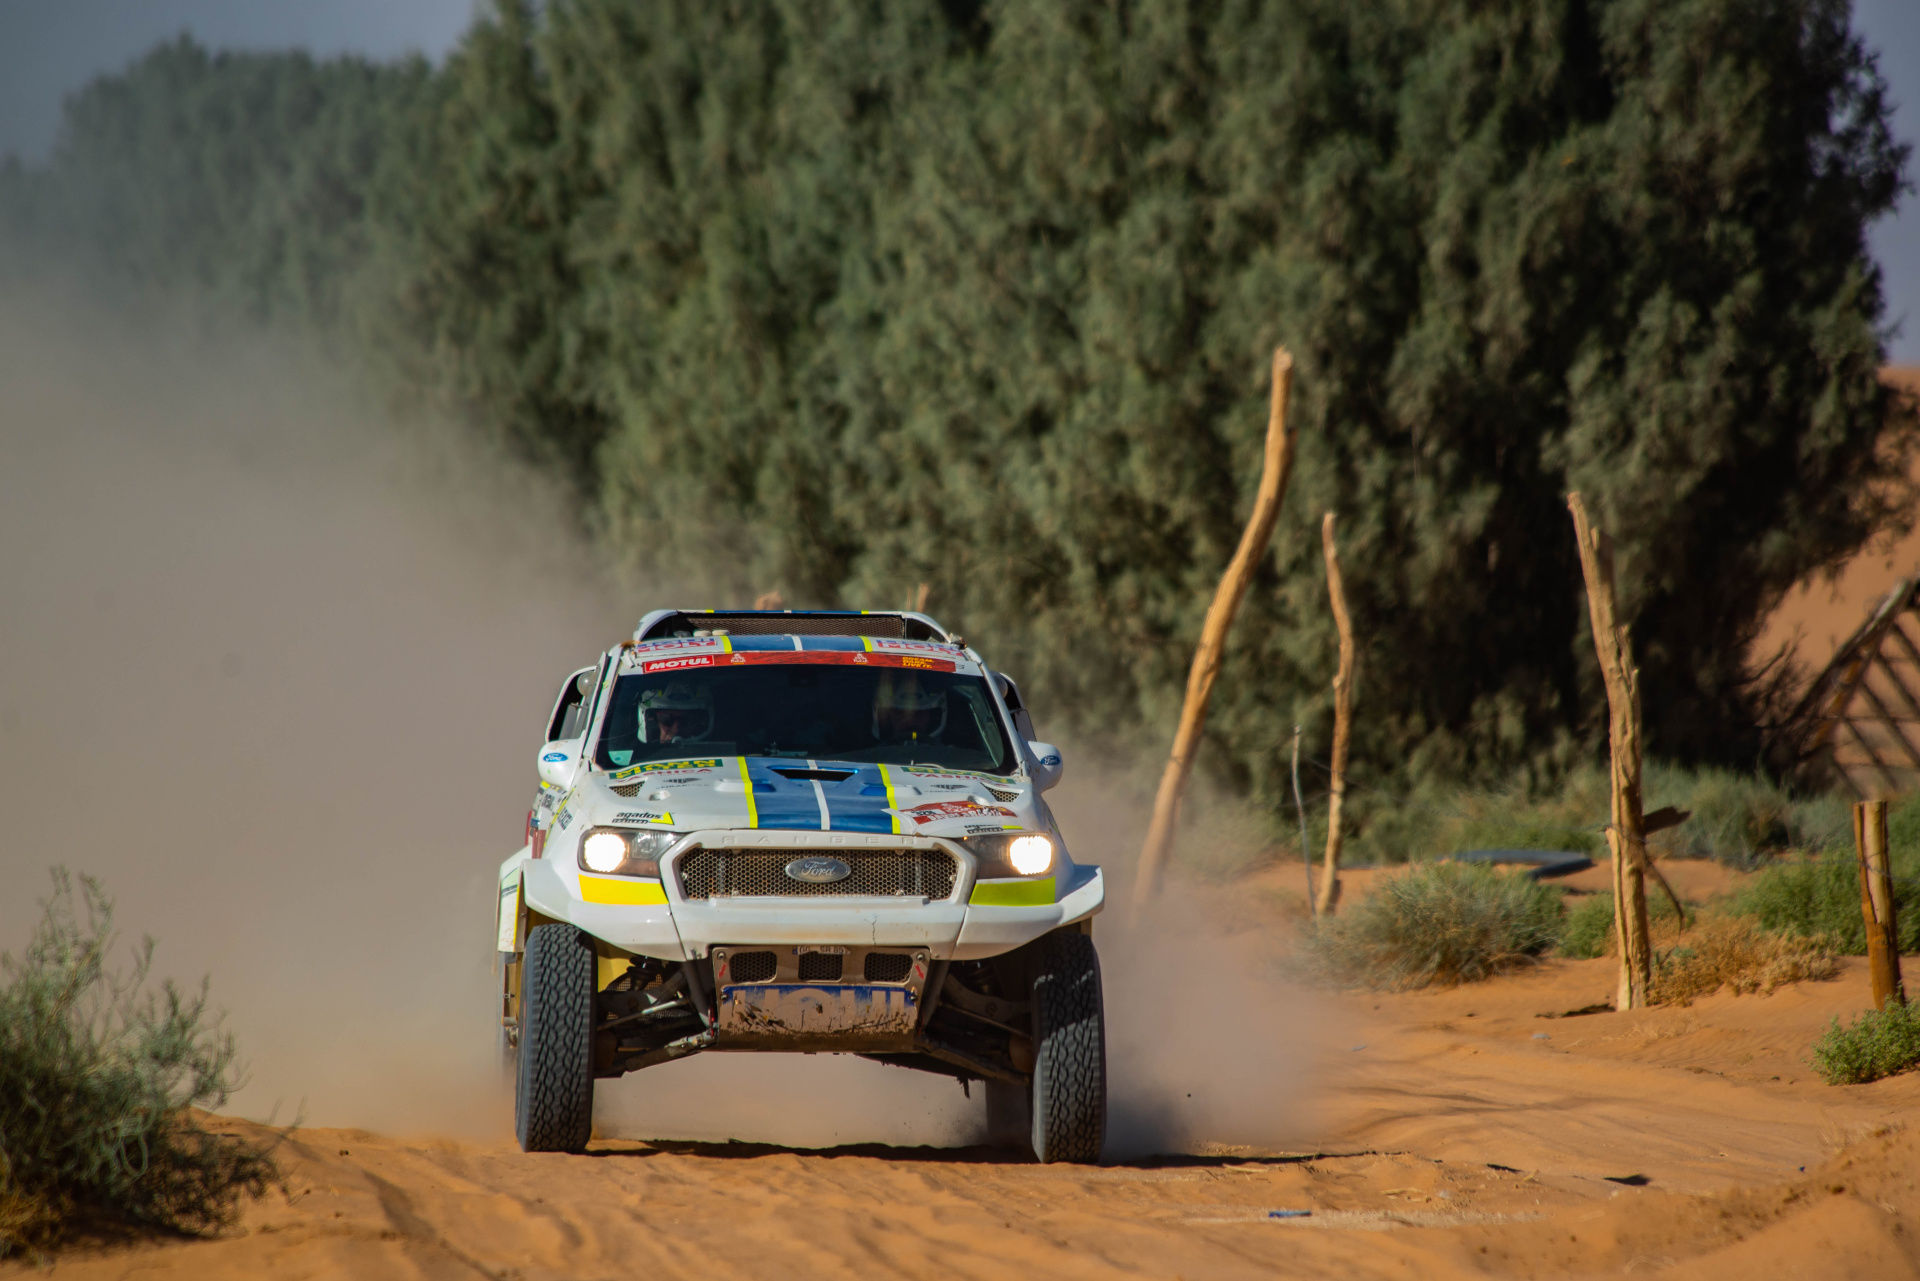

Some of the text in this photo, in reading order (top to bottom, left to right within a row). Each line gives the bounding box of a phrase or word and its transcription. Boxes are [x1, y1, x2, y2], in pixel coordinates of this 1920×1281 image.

[649, 658, 710, 671] MOTUL
[616, 812, 662, 820] agados
[801, 861, 834, 877] Ford
